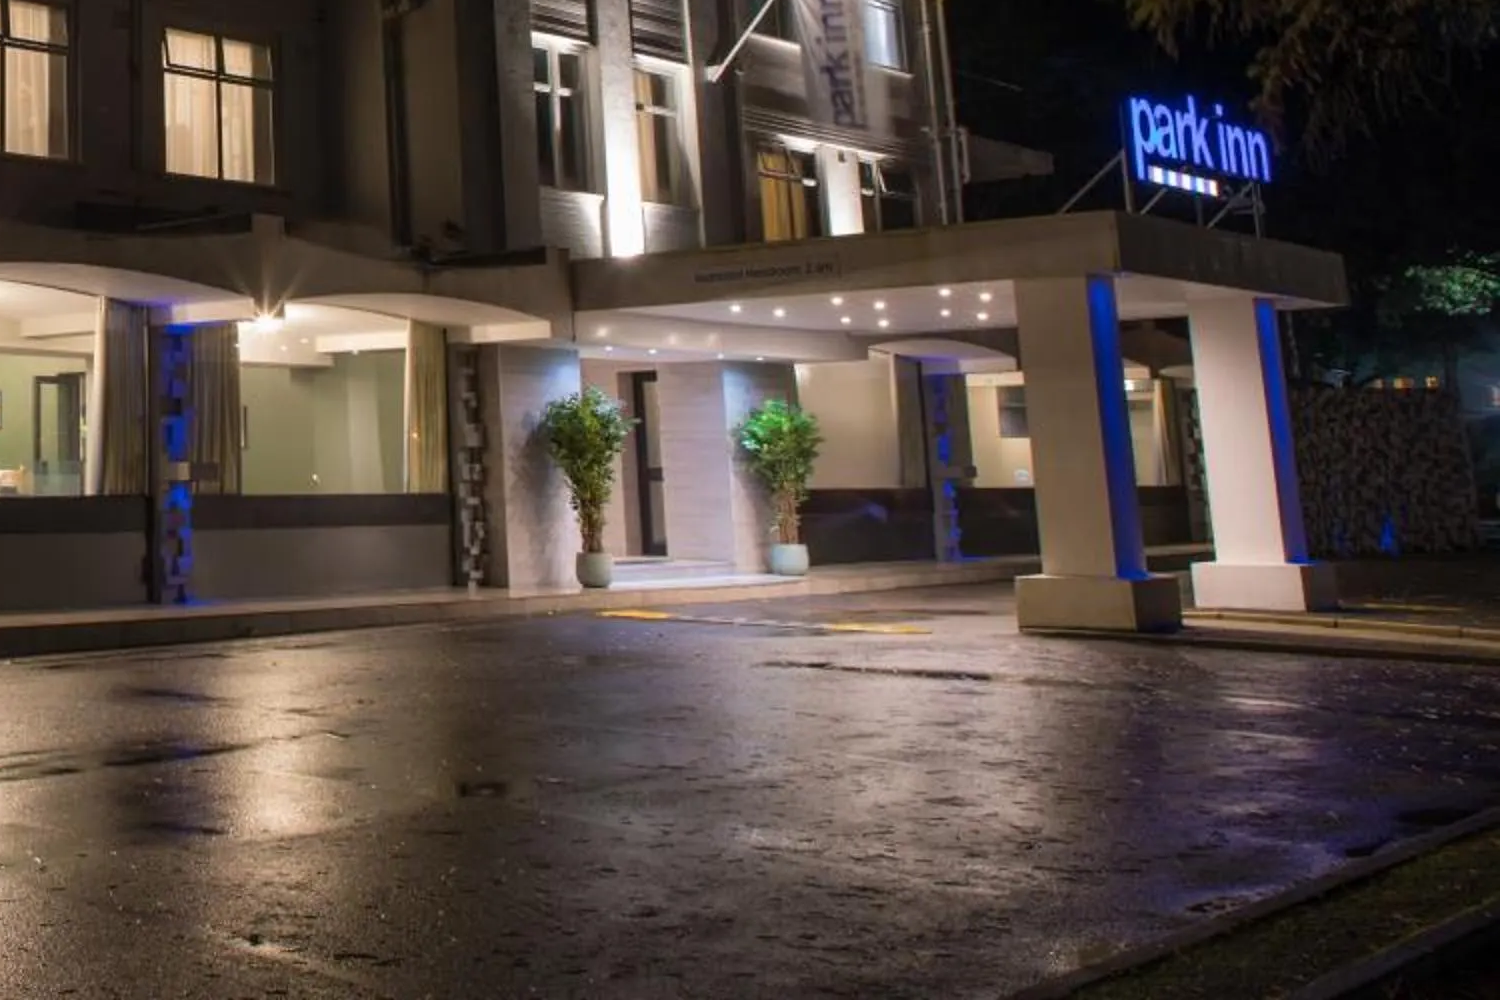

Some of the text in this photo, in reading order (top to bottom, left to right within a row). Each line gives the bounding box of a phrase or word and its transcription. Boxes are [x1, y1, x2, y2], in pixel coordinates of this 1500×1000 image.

[819, 51, 868, 129] park
[1129, 94, 1272, 183] park inn
